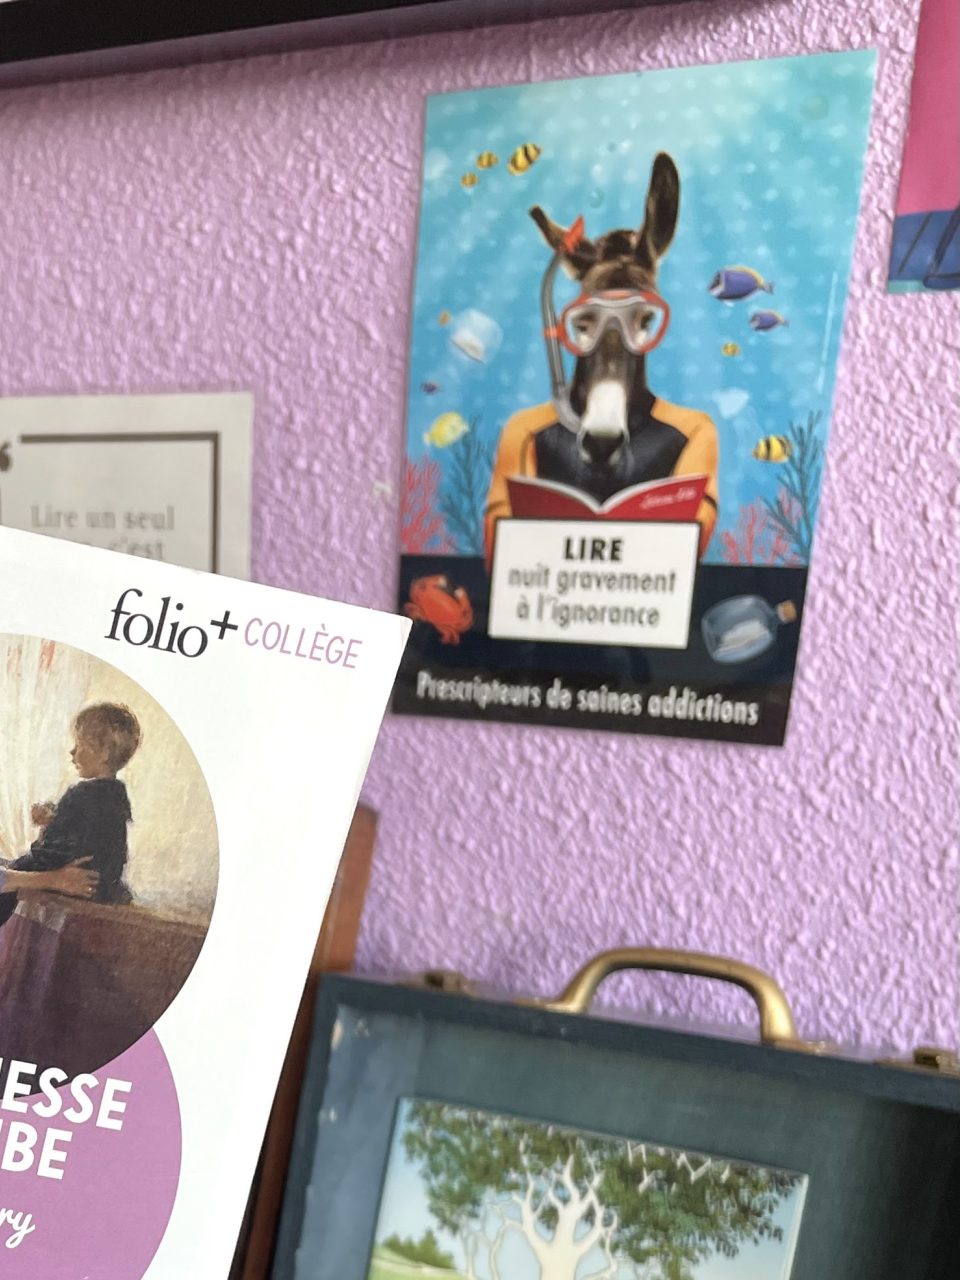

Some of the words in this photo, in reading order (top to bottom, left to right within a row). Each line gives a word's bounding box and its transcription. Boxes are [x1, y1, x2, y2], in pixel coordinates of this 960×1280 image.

[30, 505, 79, 529] Lire
[85, 510, 117, 529] un
[123, 505, 175, 530] seul
[564, 537, 624, 563] LIRE
[507, 566, 549, 587] nuit
[556, 569, 677, 594] gravement
[516, 596, 530, 620] à
[536, 597, 660, 628] l'ignorance
[244, 617, 363, 669] COLLÈGE
[416, 670, 541, 708] Prescripteurs
[545, 678, 572, 710] de
[577, 685, 642, 716] saines
[647, 687, 760, 726] addictions
